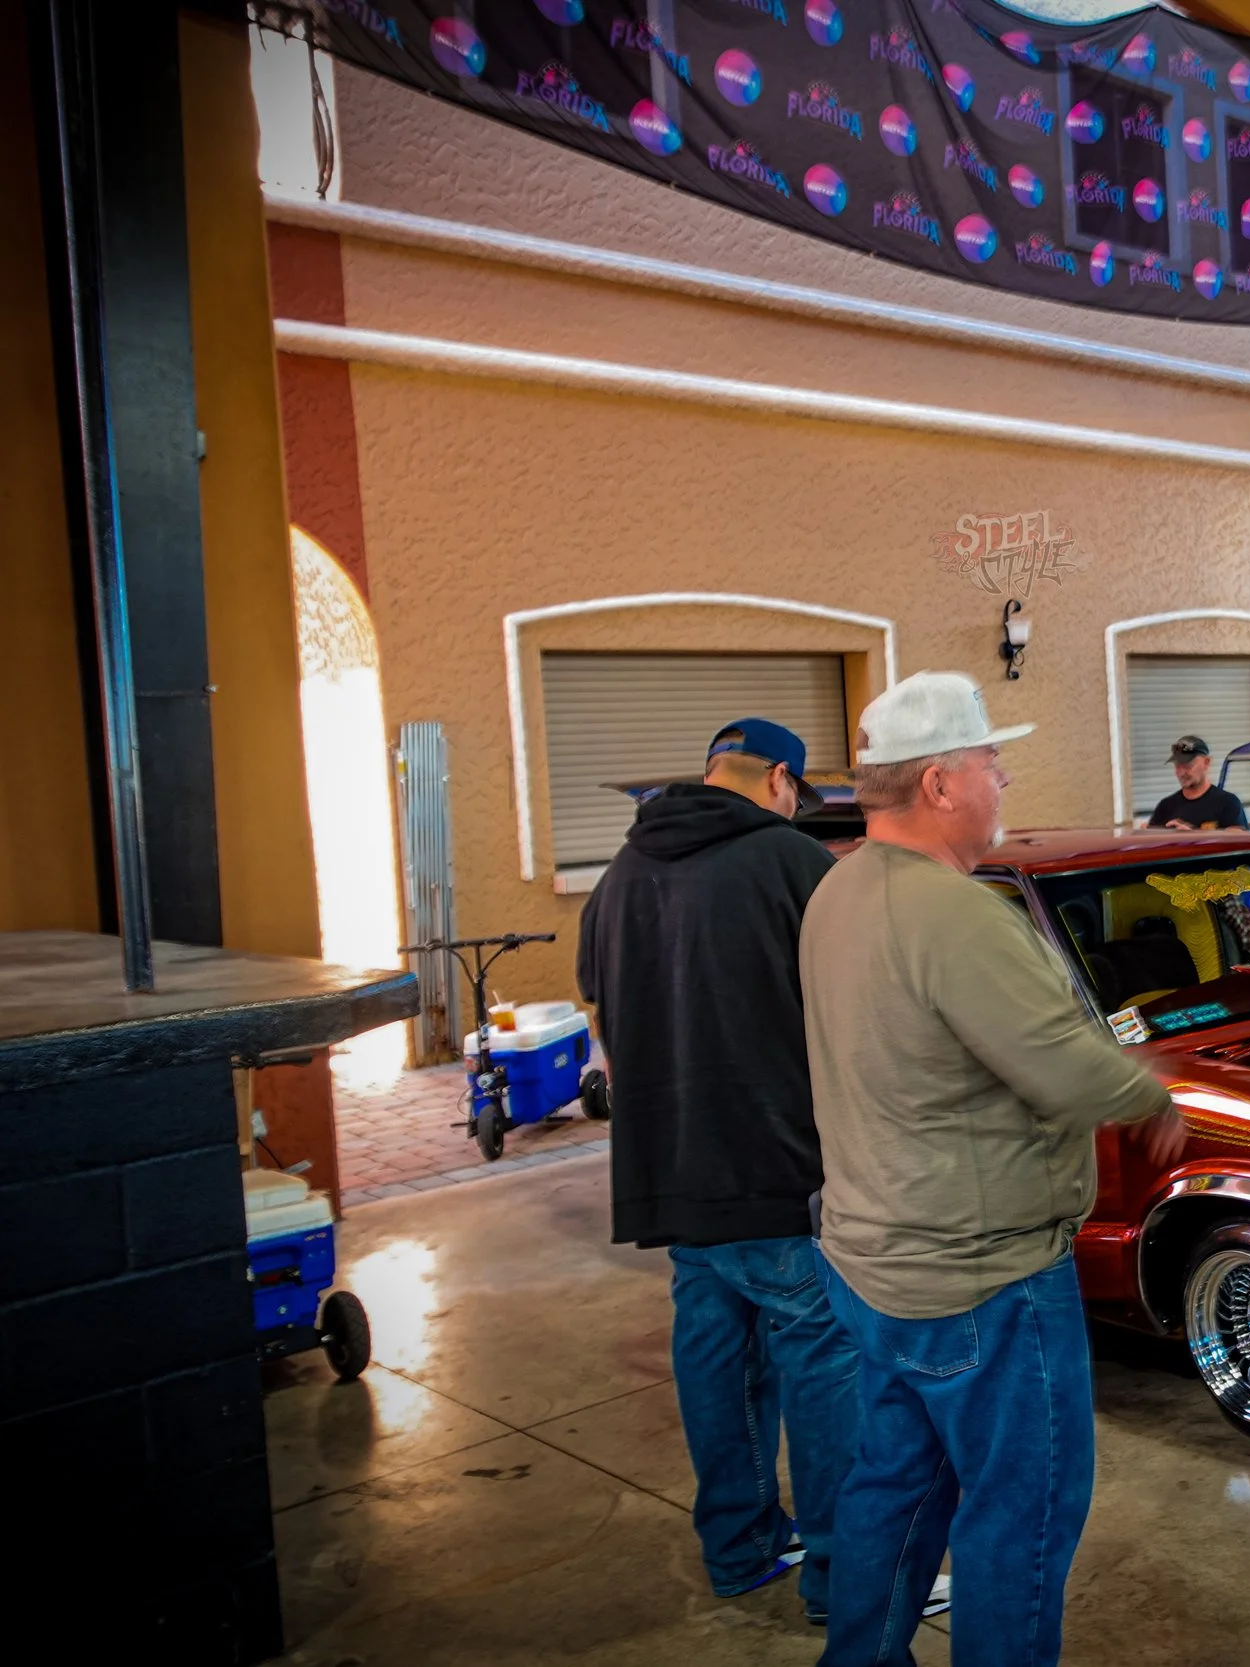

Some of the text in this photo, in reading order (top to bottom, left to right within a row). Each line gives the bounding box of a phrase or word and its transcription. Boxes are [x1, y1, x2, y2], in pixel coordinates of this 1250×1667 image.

[1168, 55, 1216, 92] FLORIDA
[515, 71, 610, 133] FLORIDA
[787, 91, 863, 141] FLORIDA
[995, 96, 1054, 136] FLORIDA
[1121, 117, 1170, 150] FLORIDA
[707, 144, 790, 199] FLORIDA
[873, 202, 942, 247] FLORIDA
[1176, 201, 1229, 232] FLORIDA
[1014, 242, 1077, 276] FLORIDA
[1129, 265, 1181, 293] FLORIDA
[955, 509, 1065, 555] STEEL
[959, 537, 1077, 600] & STYLE
